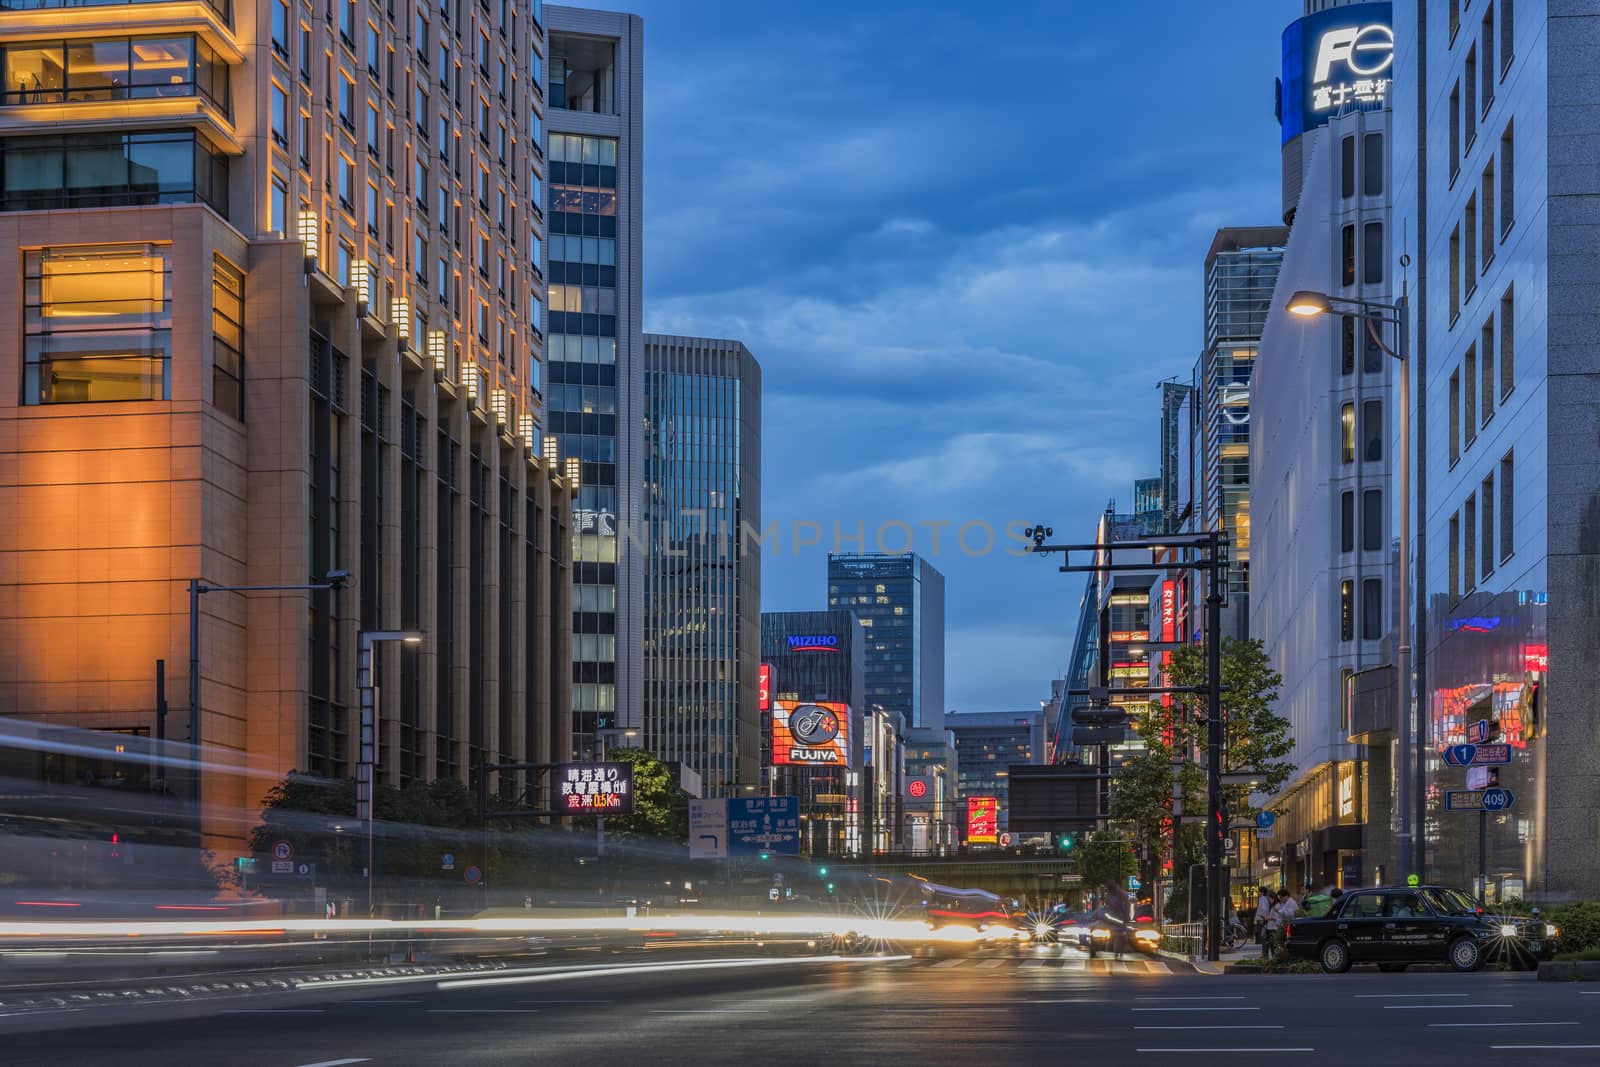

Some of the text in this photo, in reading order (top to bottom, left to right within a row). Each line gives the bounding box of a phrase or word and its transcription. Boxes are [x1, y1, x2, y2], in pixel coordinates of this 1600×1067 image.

[1163, 588, 1173, 625] カラオケ
[788, 636, 838, 646] MIZUHO
[791, 750, 838, 761] FUJIYA
[1461, 748, 1467, 760] 1
[567, 768, 618, 782] 晴海通り
[1484, 794, 1503, 805] 409
